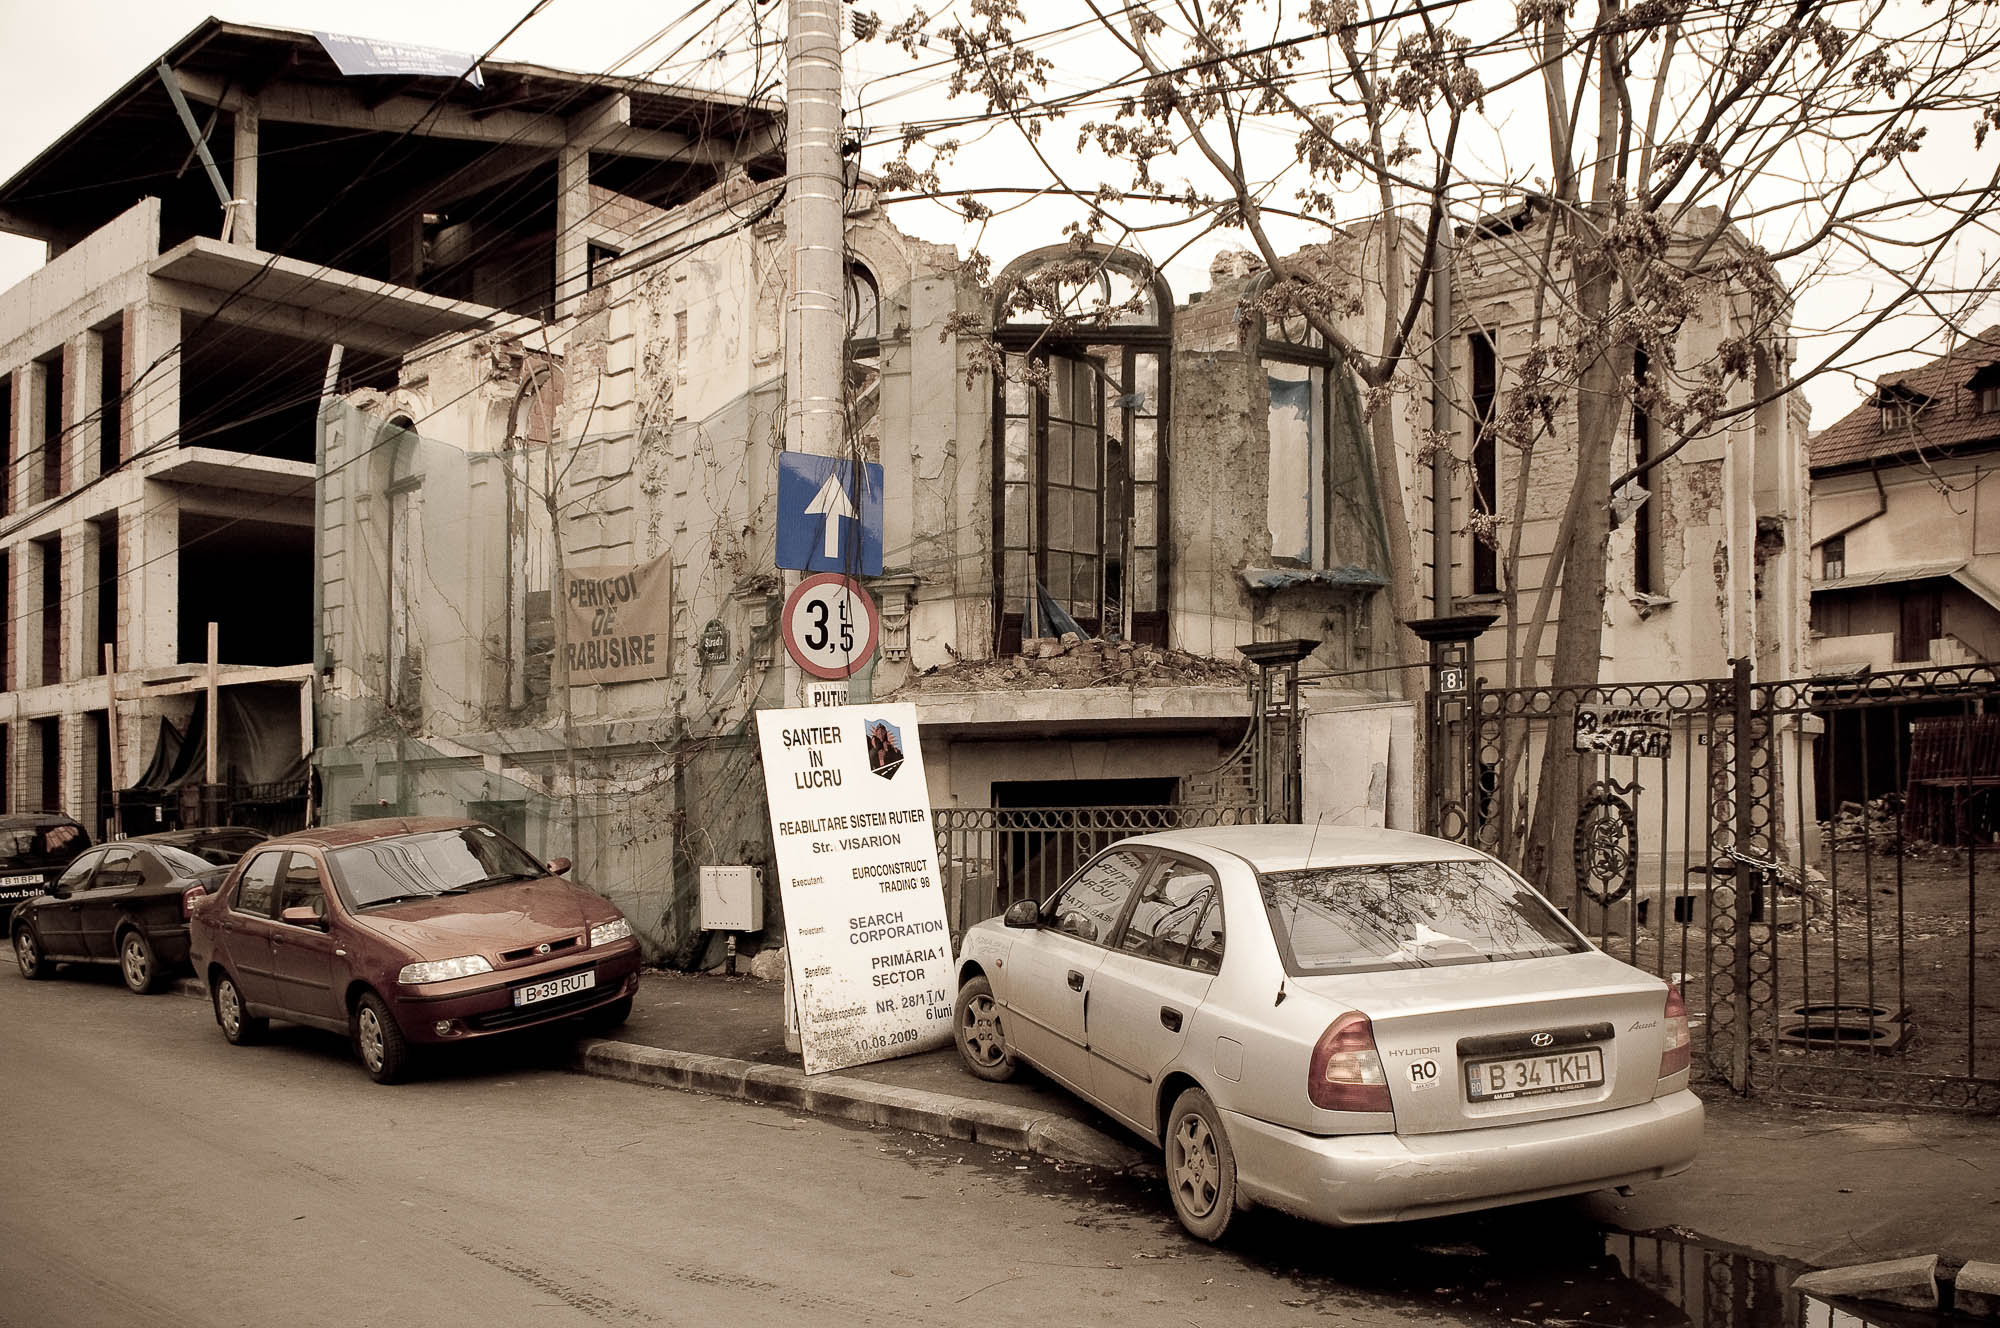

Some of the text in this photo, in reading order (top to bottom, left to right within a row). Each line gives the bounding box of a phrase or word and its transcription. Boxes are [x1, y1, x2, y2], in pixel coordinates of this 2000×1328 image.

[568, 572, 641, 608] PERICOL
[592, 607, 618, 637] DE
[561, 634, 655, 671] RABUSIRE
[1447, 673, 1456, 688] 8
[1701, 735, 1708, 745] 8
[808, 747, 824, 768] ÎN
[794, 769, 842, 790] LUCRU
[779, 809, 925, 836] REABILITARE SISTEM RUTIER
[812, 833, 902, 854] Str. VISARION
[21, 875, 40, 883] BPL
[852, 859, 927, 880] EUROCONSTRUCT
[849, 912, 903, 930] SEARCH
[850, 920, 943, 945] CORPORATION
[871, 946, 945, 970] PRIMĂRIA 1
[526, 987, 537, 1001] B
[541, 982, 558, 998] 39
[561, 974, 588, 993] RUT
[872, 967, 925, 987] SECTOR
[876, 998, 899, 1014] NR.
[926, 1008, 934, 1020] 6
[935, 1004, 952, 1018] luni
[854, 1029, 918, 1052] 10.08.2009
[1389, 1046, 1441, 1057] HYUNDAI
[1411, 1061, 1437, 1081] RO
[1489, 1055, 1591, 1091] B 34 TKH
[1471, 1082, 1481, 1093] RO
